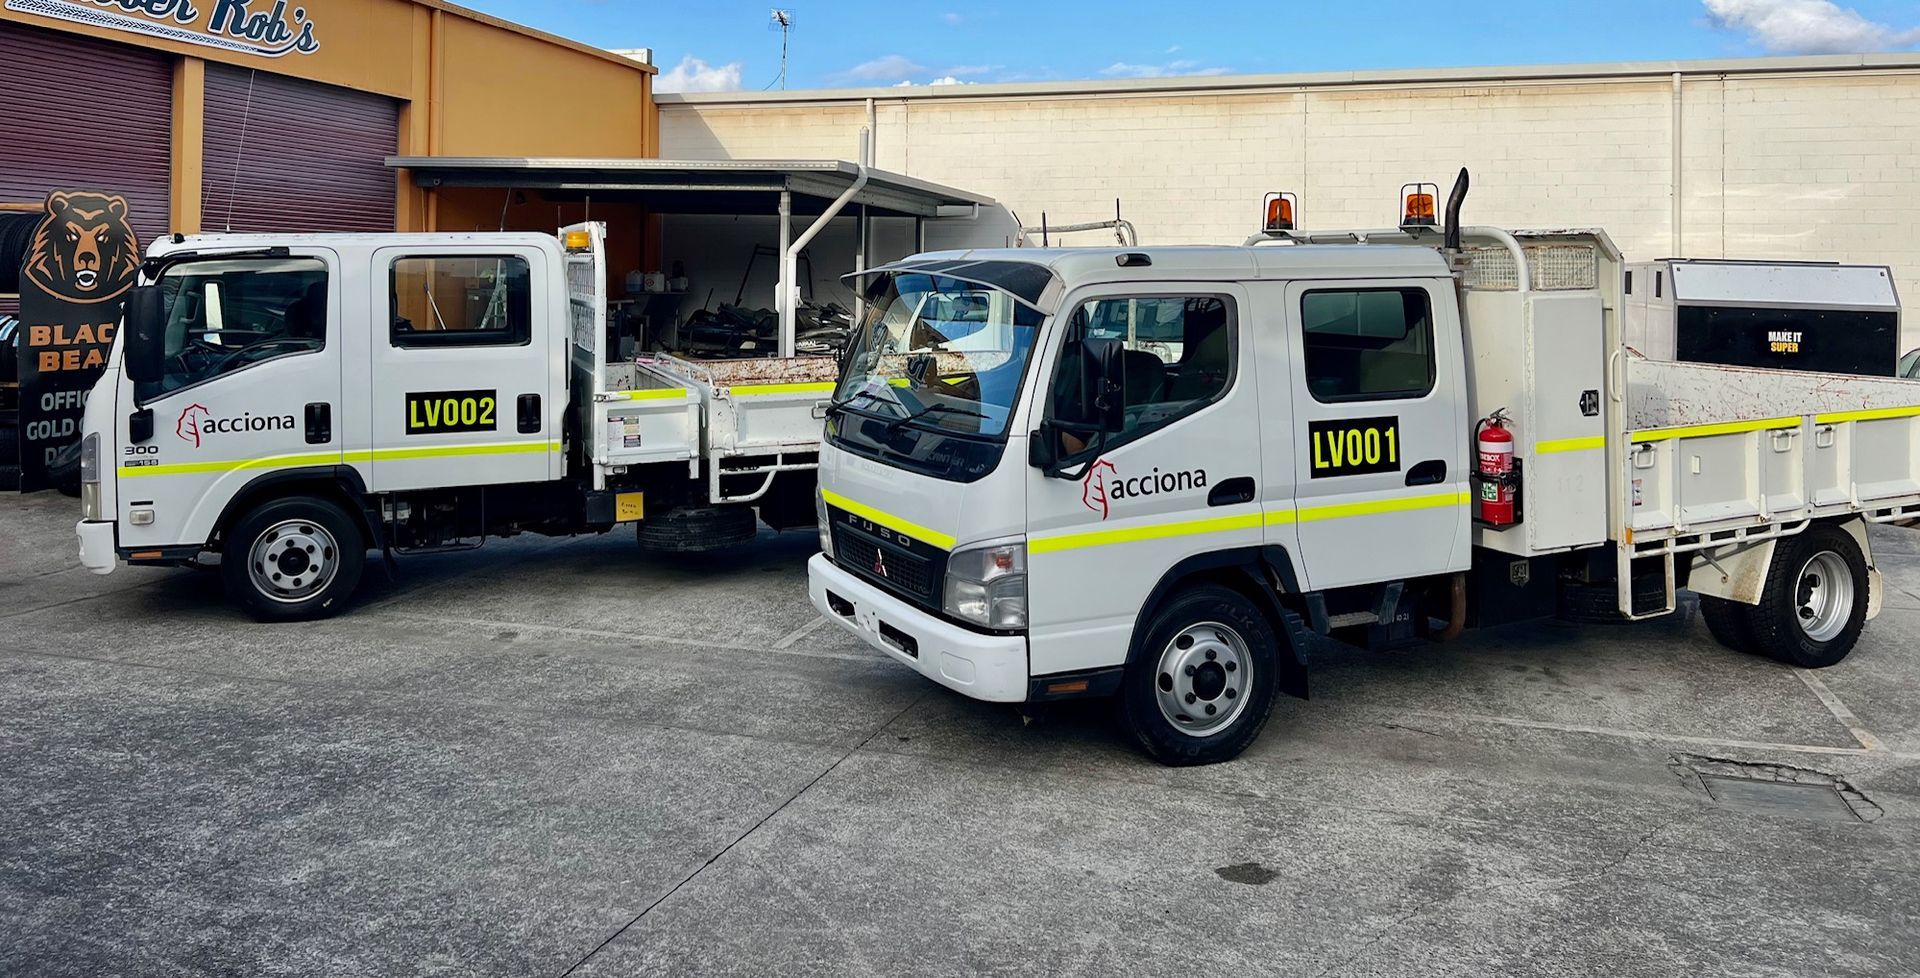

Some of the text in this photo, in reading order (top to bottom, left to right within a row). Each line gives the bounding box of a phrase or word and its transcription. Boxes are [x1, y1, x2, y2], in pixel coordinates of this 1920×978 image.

[29, 323, 114, 346] BLAC
[1768, 331, 1802, 342] MAKE IT
[1770, 342, 1798, 352] SUPER
[39, 348, 104, 372] BEA
[203, 412, 295, 434] acciona
[410, 397, 495, 428] LV002
[27, 418, 74, 440] GOLD
[125, 446, 158, 455] 300
[1314, 426, 1396, 469] LV001
[1110, 467, 1207, 499] acciona
[849, 514, 910, 547] FUSO
